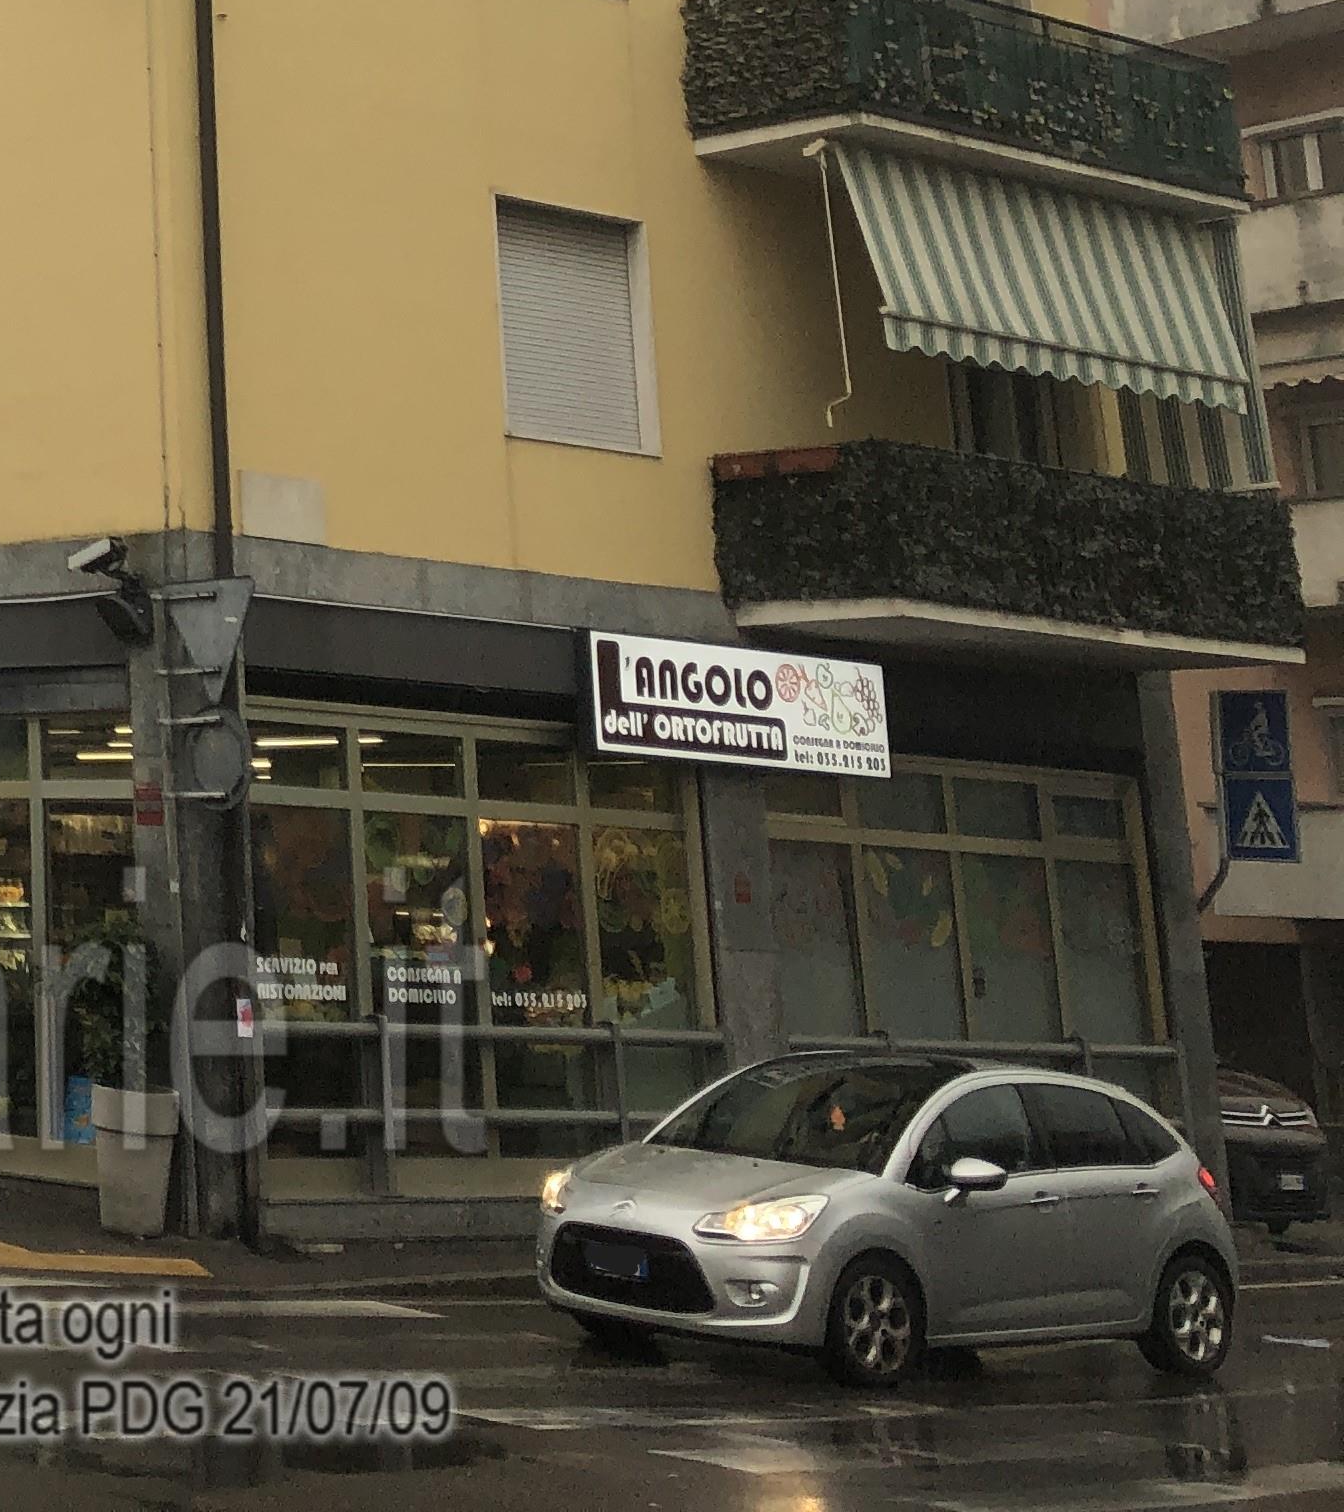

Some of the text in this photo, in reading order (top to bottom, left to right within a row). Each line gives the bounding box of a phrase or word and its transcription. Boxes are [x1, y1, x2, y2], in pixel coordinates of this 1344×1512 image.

[604, 708, 784, 751] dell' ORTOFRUTTA
[794, 749, 814, 764] tel:
[256, 957, 316, 975] SERVIZIO
[386, 966, 451, 984] CONSEGNA
[257, 982, 347, 1002] RISTORAZIONI
[388, 987, 457, 1005] DOMICILIO
